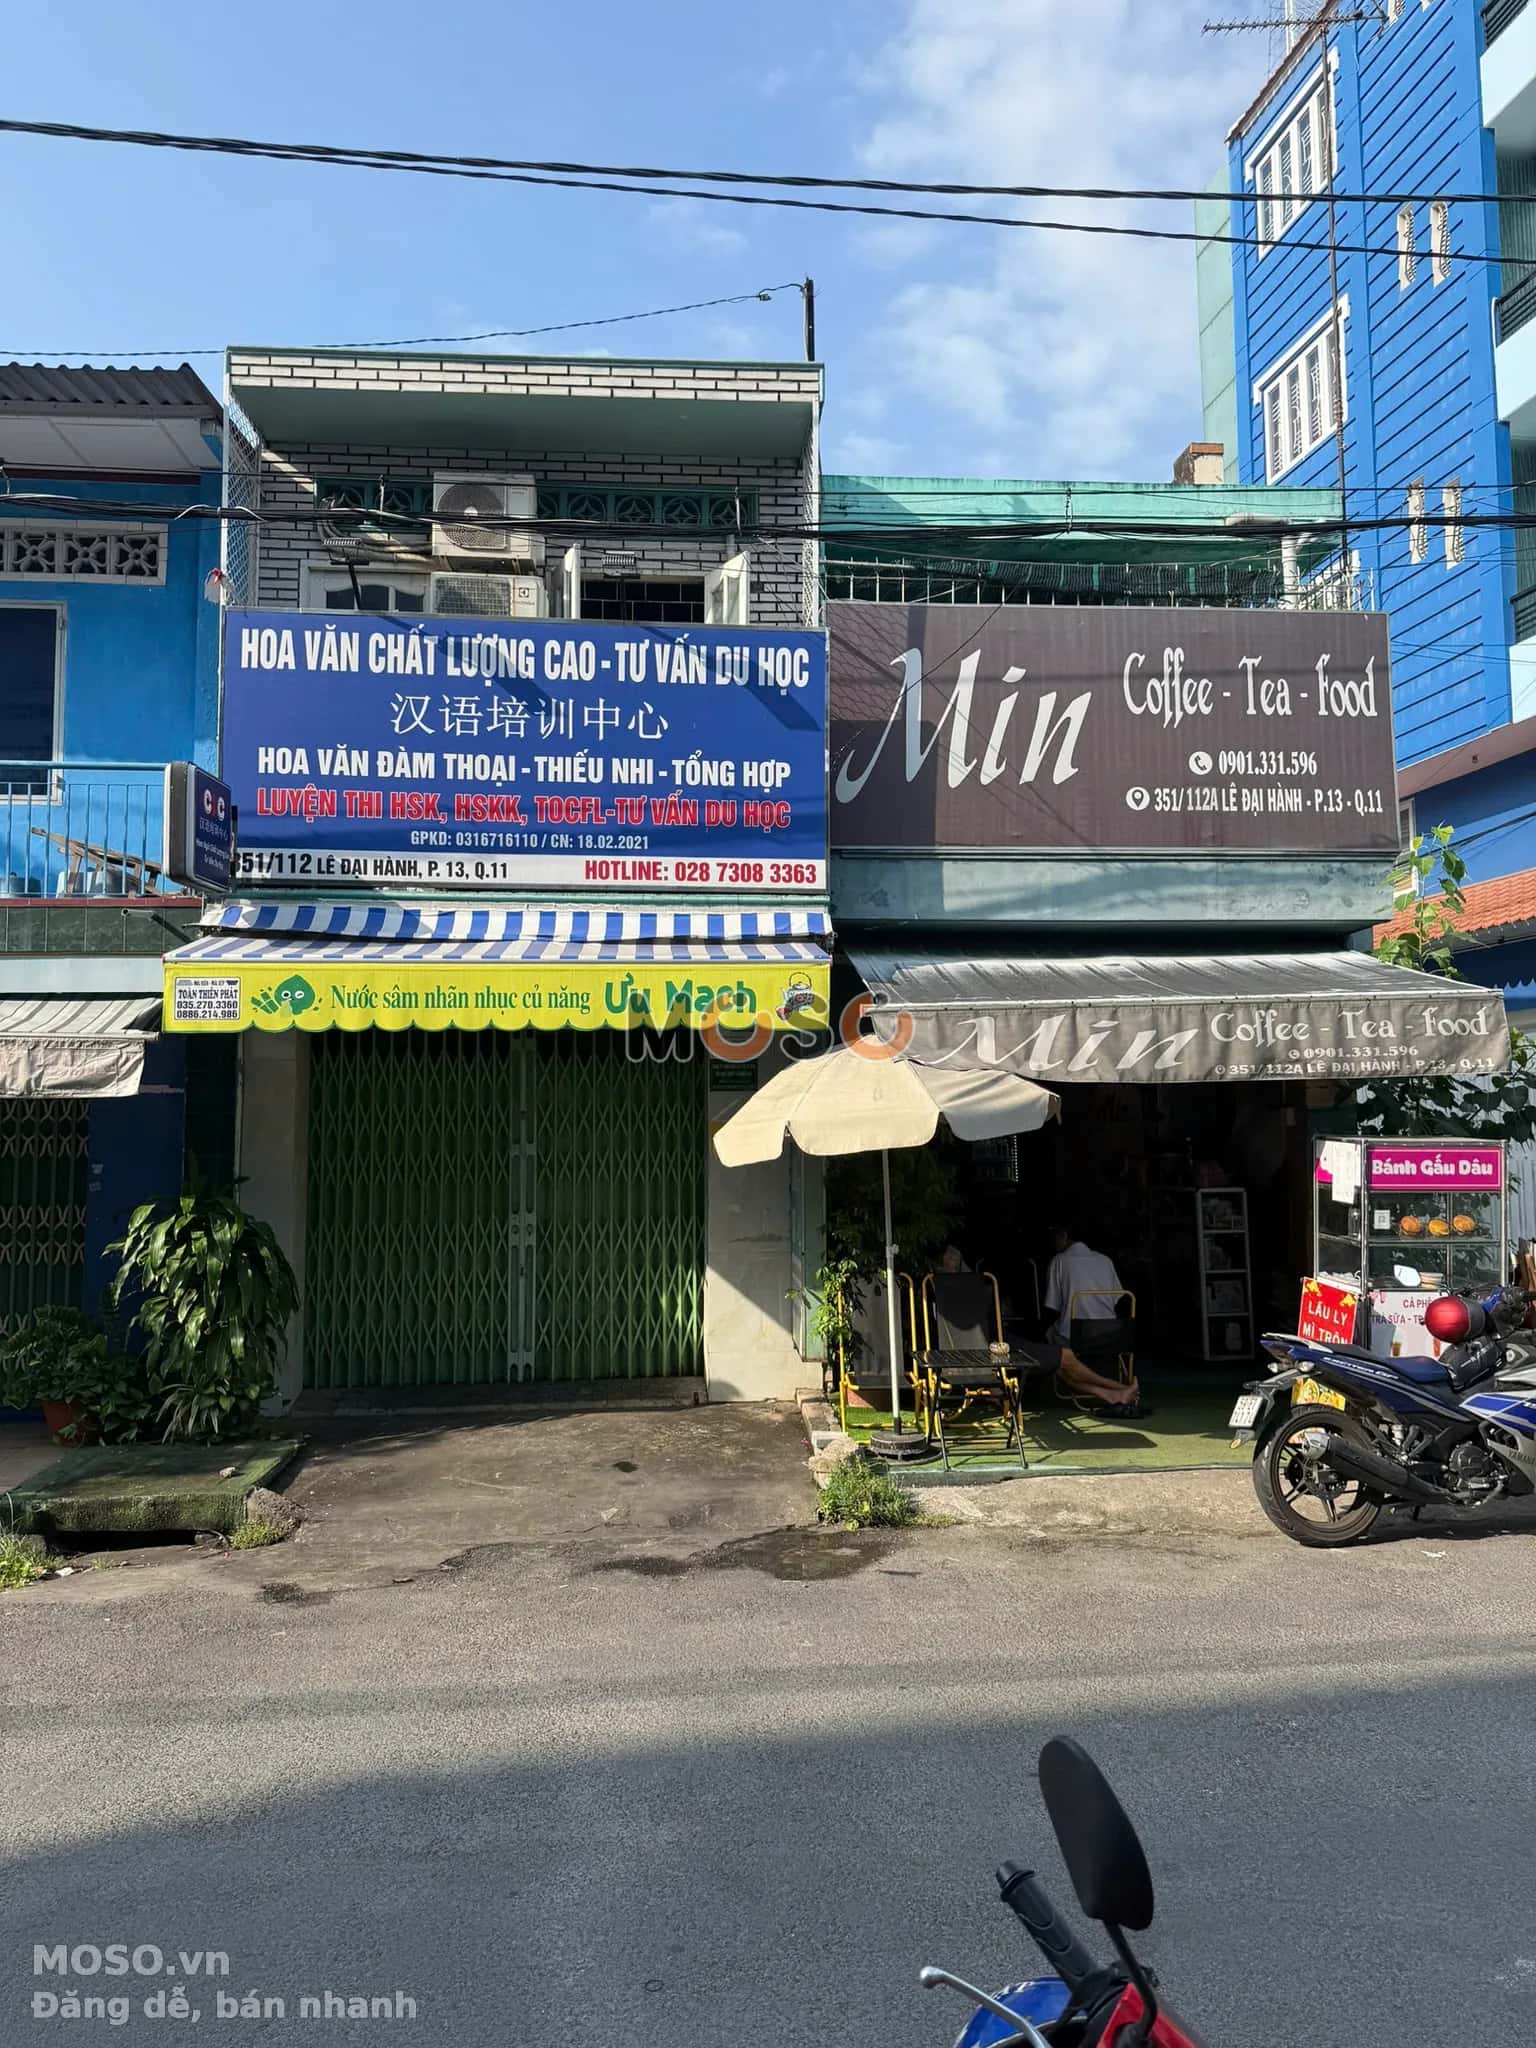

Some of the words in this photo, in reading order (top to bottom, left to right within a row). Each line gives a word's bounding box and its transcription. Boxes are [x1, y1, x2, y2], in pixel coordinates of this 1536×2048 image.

[241, 629, 295, 670] HOA
[304, 624, 360, 673] VĂN
[369, 623, 438, 676] CHẤT
[448, 634, 535, 687] LƯỢNG
[544, 642, 596, 682] CAO
[616, 640, 650, 683] TƯ
[652, 633, 707, 684] VẤN
[715, 645, 750, 686] DU
[758, 647, 809, 696] HỌC
[1123, 647, 1214, 729] Coffee
[1238, 655, 1292, 716] Tea
[390, 692, 669, 740] 汉语培训中心
[835, 648, 1093, 803] Min
[258, 746, 308, 775] HOA
[316, 742, 368, 777] VĂN
[378, 744, 434, 780] ĐÀM
[443, 752, 516, 788] THOẠI
[534, 747, 603, 785] THIẾU
[612, 757, 654, 786] NHI
[672, 748, 735, 787] TỔNG
[743, 760, 790, 792] HỢP
[1218, 751, 1318, 776] 0901.331.596
[258, 784, 336, 823] LUYỆN
[344, 792, 384, 820] THI
[390, 793, 448, 826] HSK,
[455, 794, 528, 827] HSKK,
[650, 789, 698, 828] VẤN
[706, 800, 737, 828] DU
[744, 800, 791, 832] HỌC
[1222, 782, 1238, 813] LÊ
[1241, 788, 1264, 818] ĐẠI
[1267, 784, 1302, 813] HÀNH
[1314, 788, 1342, 813] P.13
[1355, 788, 1383, 815] Q.11
[410, 832, 452, 846] GPKD:
[456, 832, 538, 848] 0316716110
[550, 834, 574, 849] CN:
[578, 835, 648, 850] 18.02.2021
[317, 853, 336, 874] LÊ
[339, 856, 368, 879] ĐẠI
[372, 854, 423, 879] HÀNH,
[446, 860, 470, 881] 13,
[474, 861, 508, 881] Q.11
[584, 862, 668, 882] HOTLINE:
[674, 862, 710, 882] 028
[718, 862, 764, 883] 7308
[770, 864, 816, 884] 3363
[331, 985, 378, 1009] Nước
[382, 985, 419, 1009] sâm
[423, 985, 469, 1009] nhãn
[474, 985, 517, 1016] nhục
[522, 985, 541, 1009] củ
[548, 984, 591, 1014] năng
[912, 1013, 1200, 1072] Min
[1210, 1009, 1310, 1047] Coffee
[1338, 1008, 1396, 1038] Tea
[1303, 1046, 1418, 1059] 0901.331.596
[1372, 1159, 1417, 1175] Bánh
[1420, 1153, 1455, 1176] Gấu
[1459, 1158, 1493, 1175] Dâu
